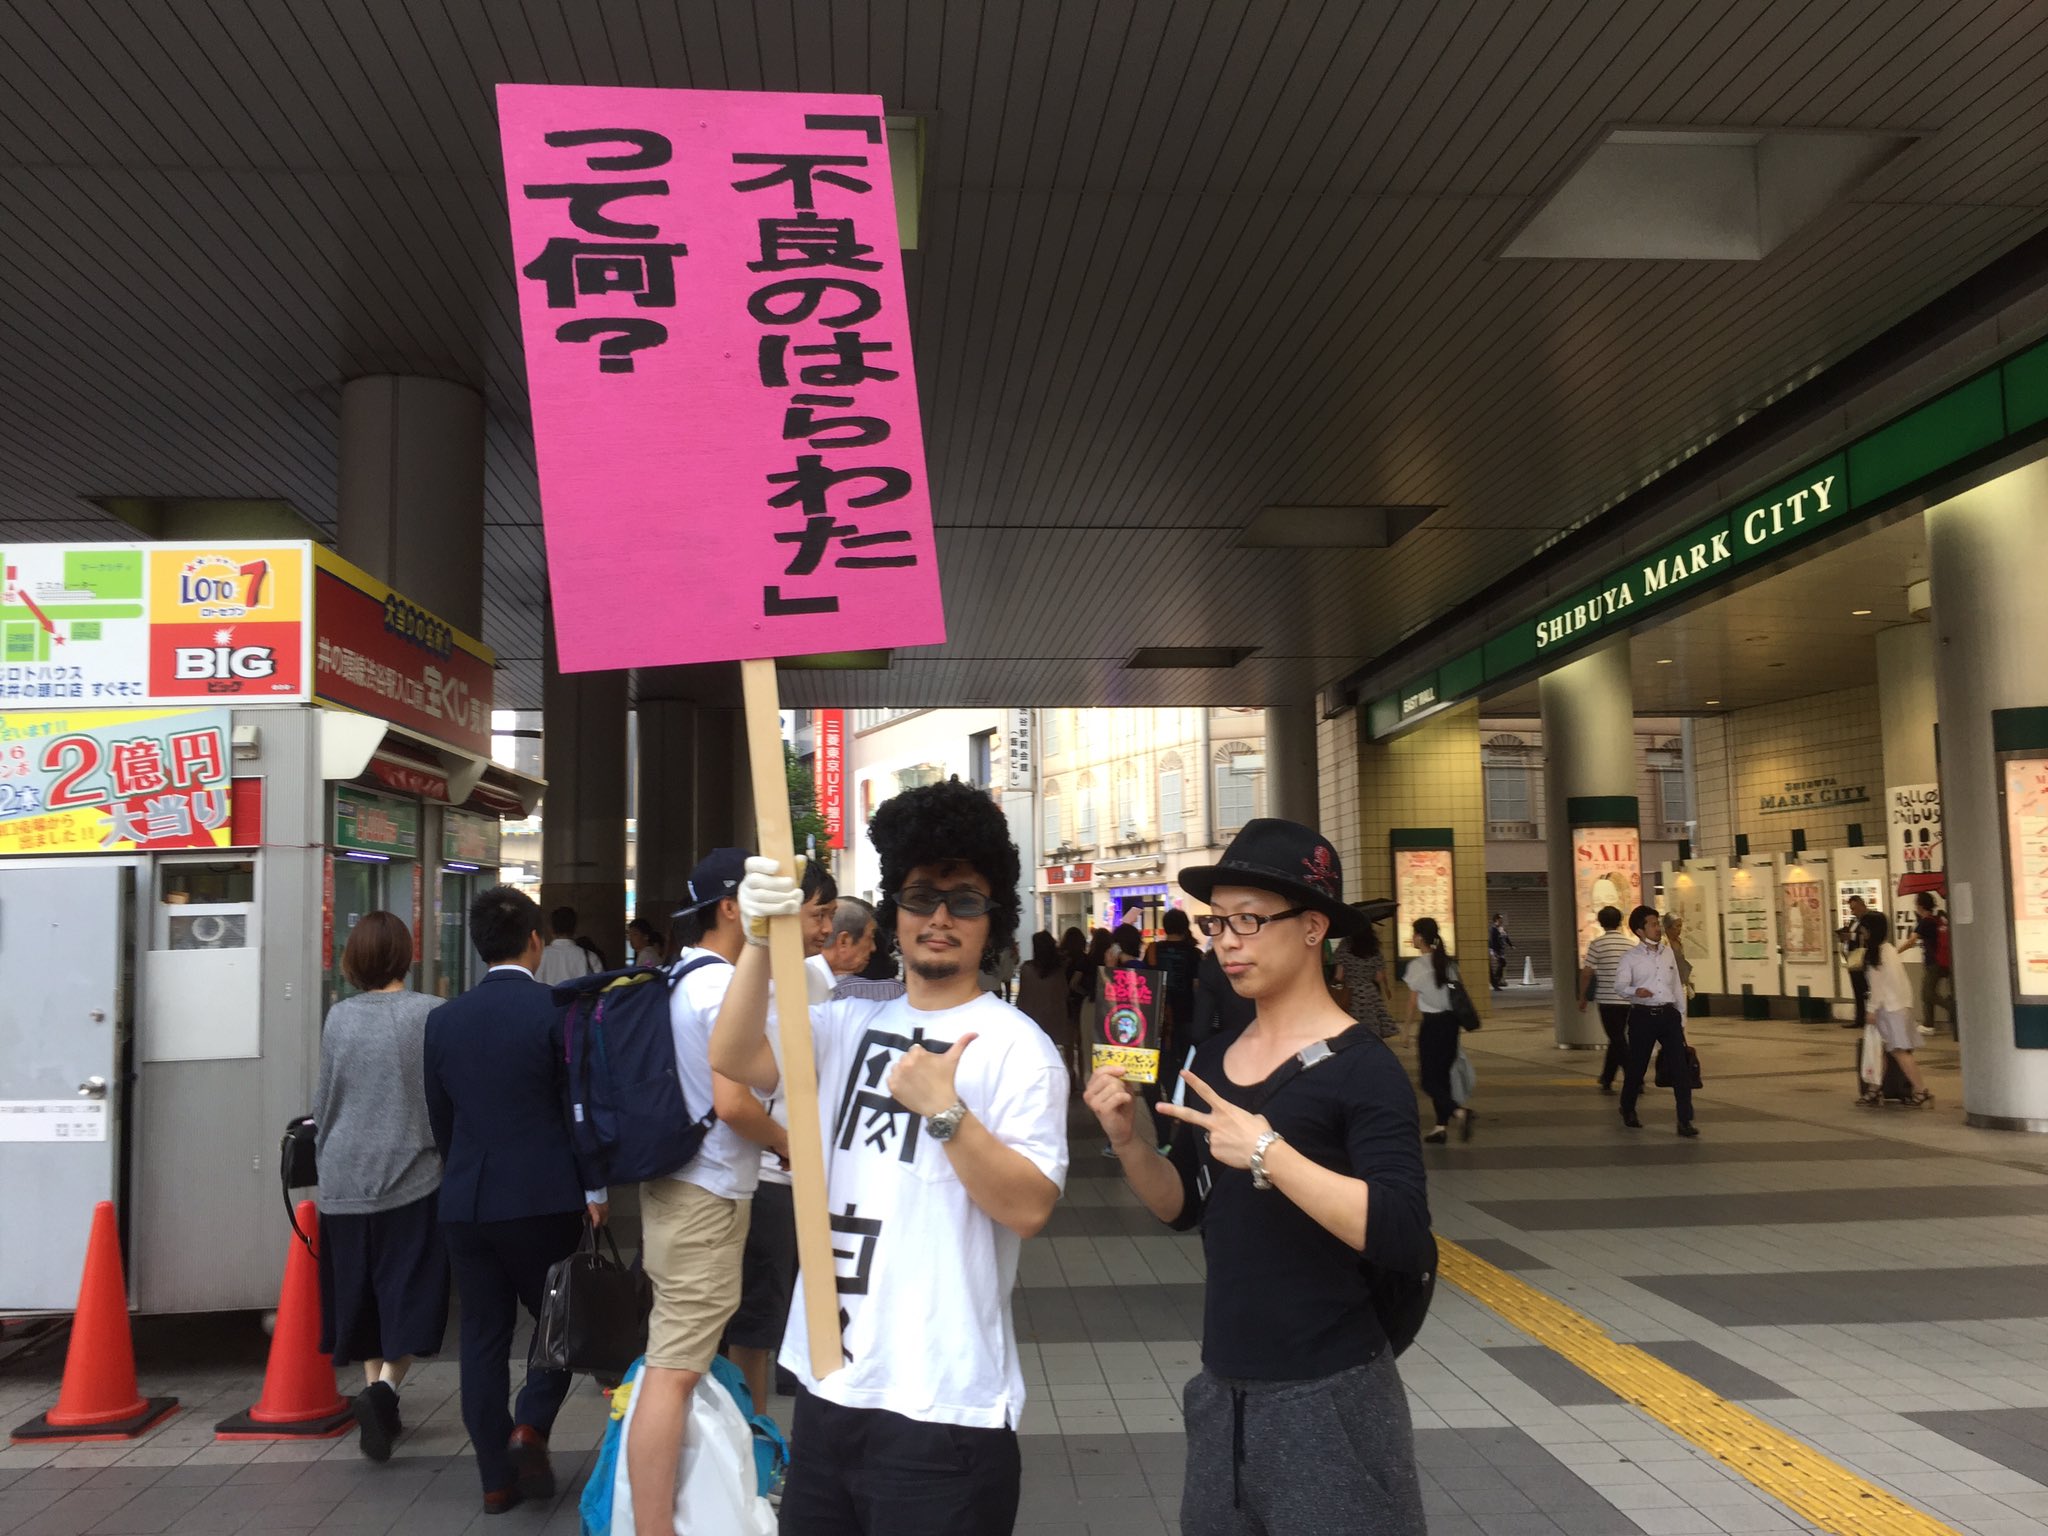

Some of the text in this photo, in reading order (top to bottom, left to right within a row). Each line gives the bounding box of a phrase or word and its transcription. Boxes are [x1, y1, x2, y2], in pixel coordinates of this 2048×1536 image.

[523, 128, 688, 374] って何？
[731, 114, 917, 616] 「不良のはらわた」
[181, 559, 269, 608] LOTO 7
[1536, 475, 1836, 649] SHIBUYA MARK CITY
[91, 681, 143, 697] すぐそこ
[173, 645, 277, 680] BIG
[39, 727, 224, 811] 2億円
[1819, 785, 1867, 802] CITY
[98, 787, 230, 848] 大当り
[1576, 843, 1638, 862] SALE
